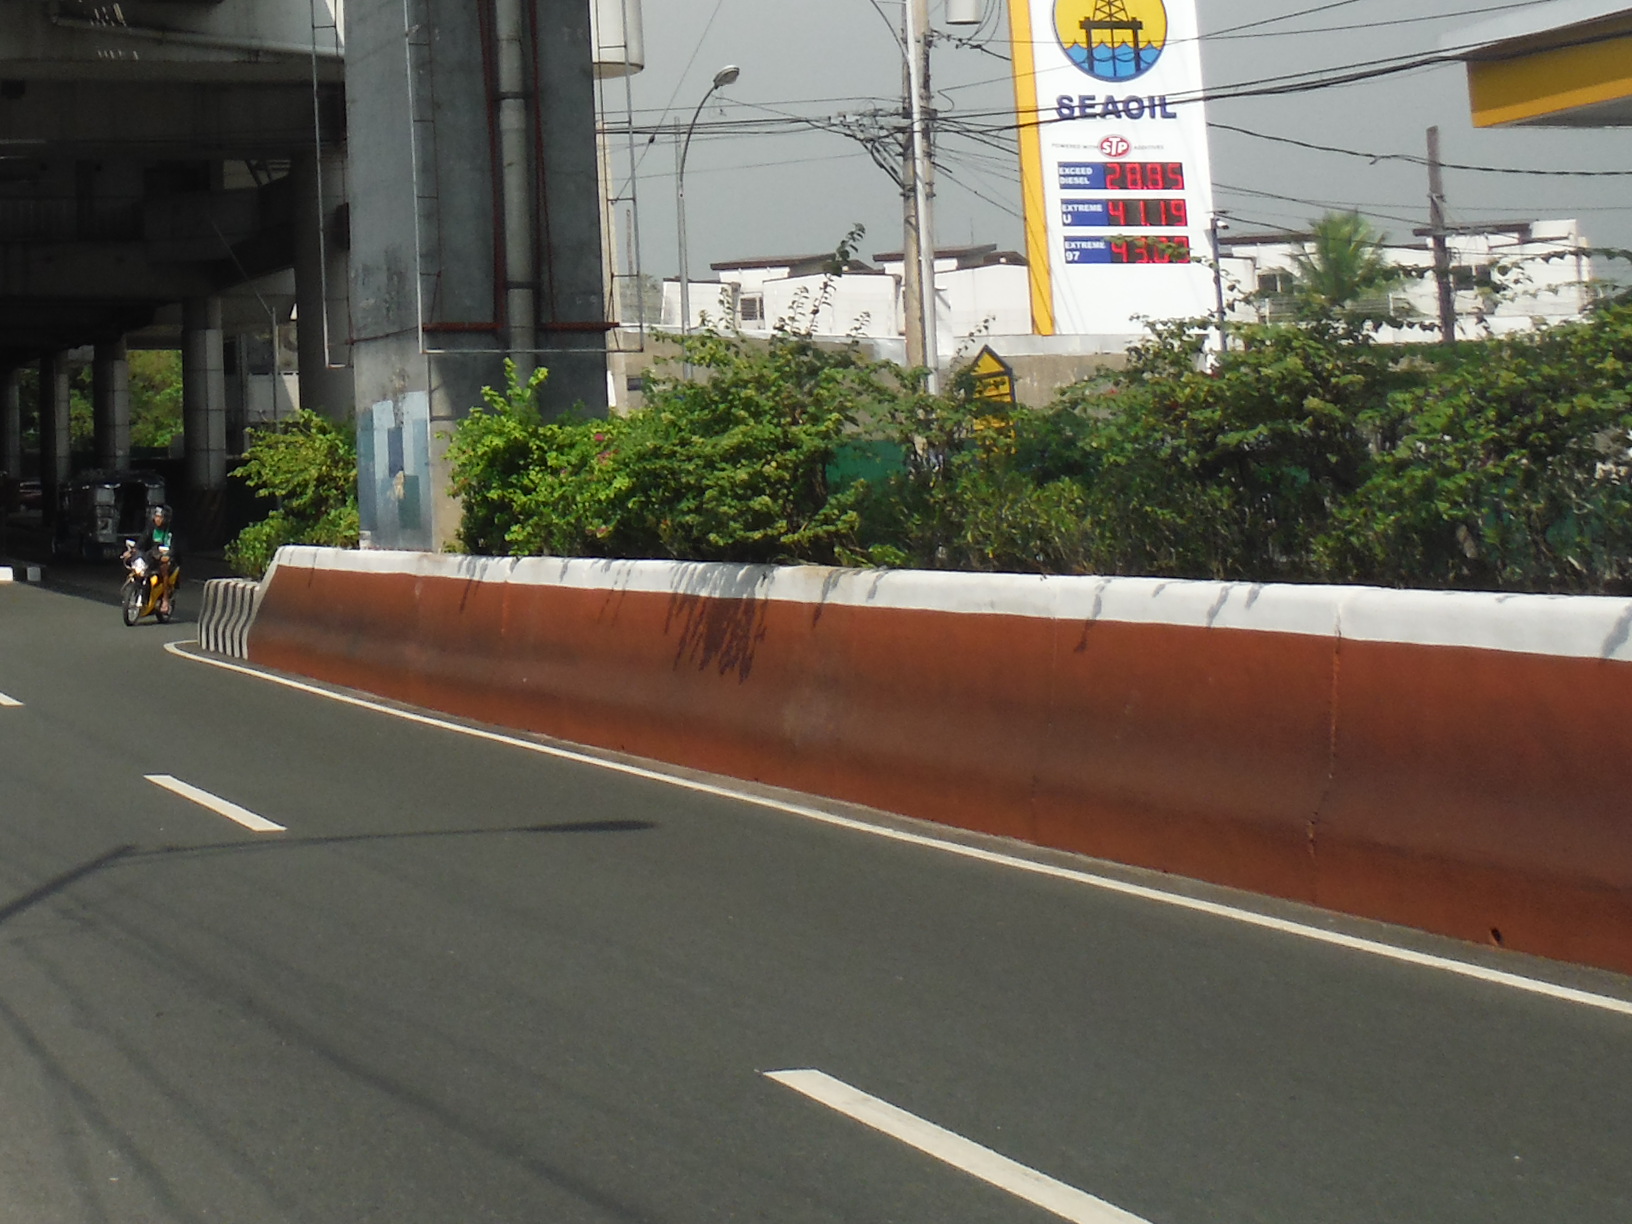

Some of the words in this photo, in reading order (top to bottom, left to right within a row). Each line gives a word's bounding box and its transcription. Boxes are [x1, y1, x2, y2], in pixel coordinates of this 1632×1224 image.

[1055, 94, 1177, 120] SEAOIL
[1101, 137, 1130, 156] STP
[1059, 167, 1093, 175] EXCEED
[1060, 176, 1090, 185] DIESEL
[1062, 204, 1103, 212] EXTREME
[1063, 214, 1072, 224] U
[1065, 241, 1106, 249] EXTREME
[1066, 251, 1080, 261] 97
